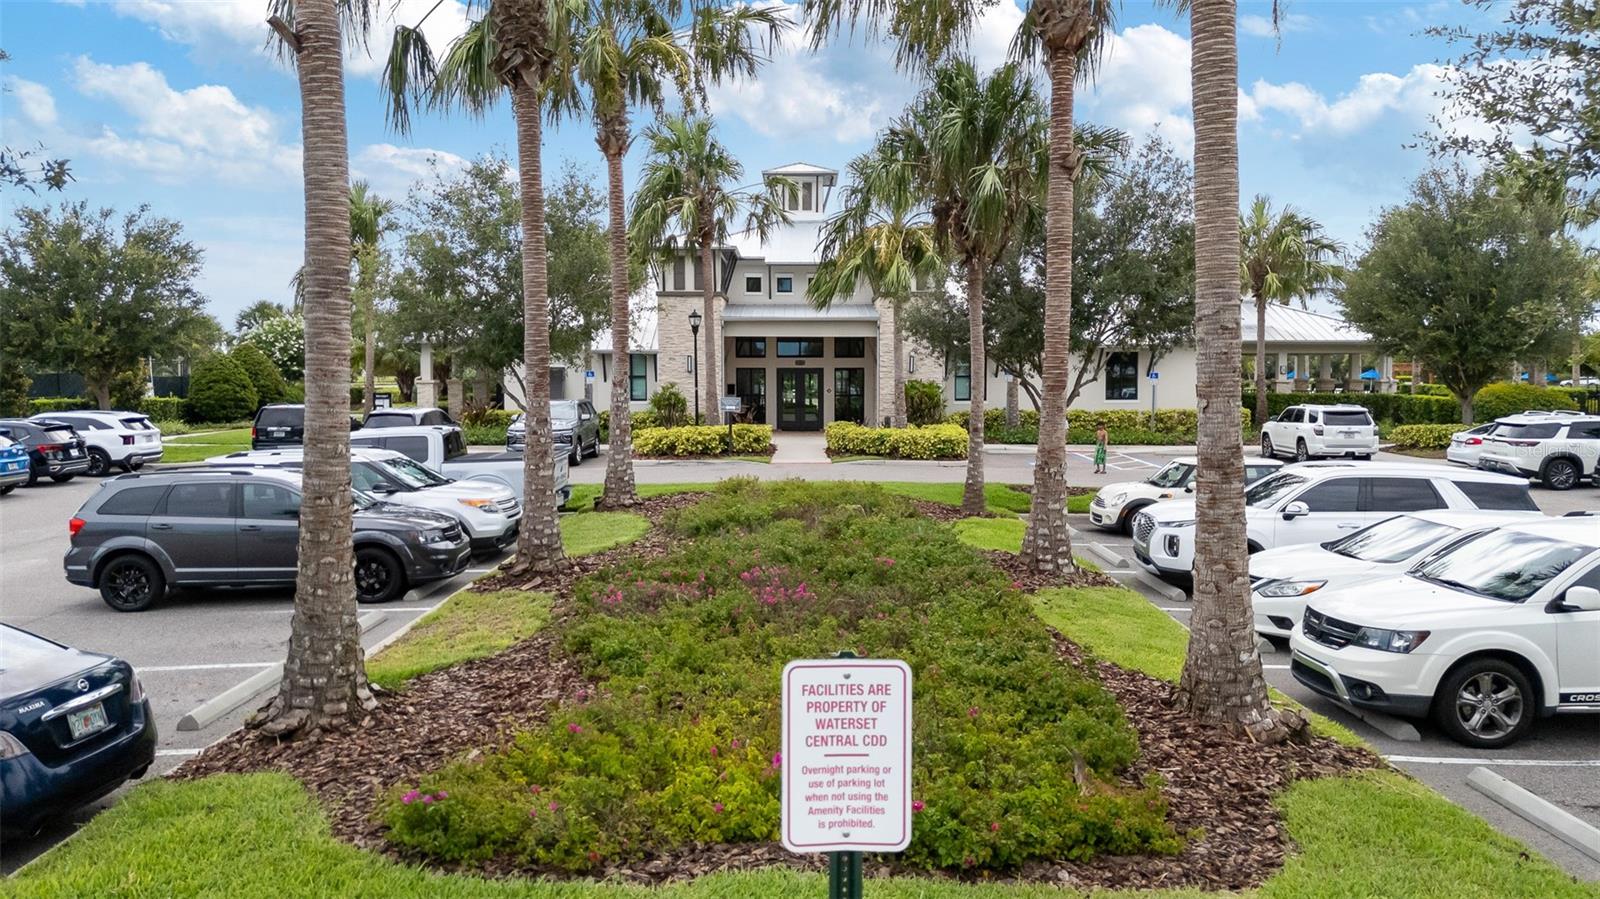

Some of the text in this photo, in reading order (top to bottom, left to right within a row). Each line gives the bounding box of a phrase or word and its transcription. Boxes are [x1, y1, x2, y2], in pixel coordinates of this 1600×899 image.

[802, 683, 892, 696] FACILITIES ARE
[1570, 694, 1600, 702] CROS
[18, 701, 45, 714] MAXIMA
[806, 700, 887, 713] PROPERTY OF
[815, 717, 878, 730] WATERSET
[805, 734, 888, 747] CENTRAL CDD
[801, 765, 892, 776] Overnight parking or
[826, 779, 835, 788] of
[838, 778, 871, 789] parking
[874, 779, 885, 788] lot
[805, 791, 889, 803] when not using the
[808, 805, 886, 816] Amenity Facilities
[818, 818, 876, 830] is prohibited.
